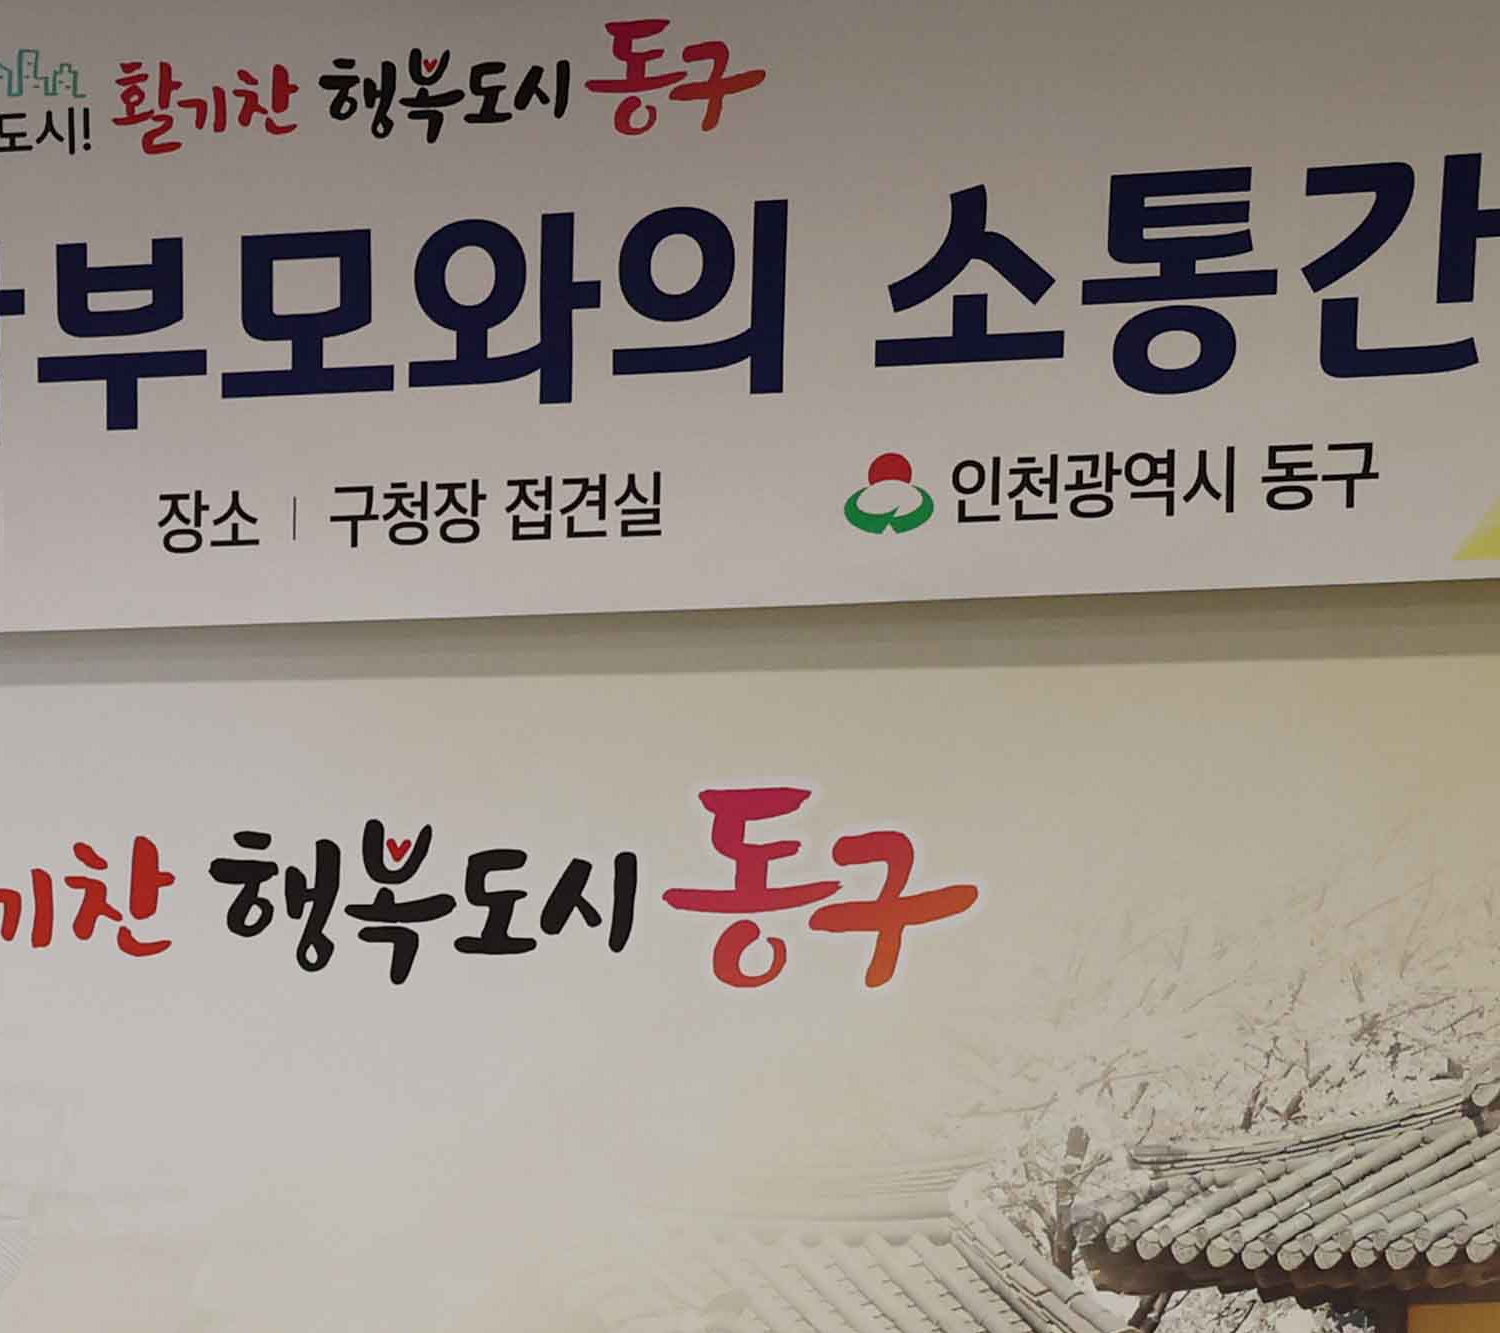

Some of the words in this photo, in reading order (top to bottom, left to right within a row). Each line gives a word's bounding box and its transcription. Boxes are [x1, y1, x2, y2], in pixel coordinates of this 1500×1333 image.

[111, 61, 300, 155] 활기찬
[318, 47, 571, 141] 행복도시
[584, 18, 766, 136] 동구
[874, 152, 1500, 395] 소통간
[157, 489, 260, 554] 장소
[329, 478, 487, 548] 구청장
[505, 471, 662, 541] 접견실
[951, 445, 1236, 523] 인천광역시
[1261, 442, 1380, 511] 동구
[208, 818, 638, 986] 행복도시
[661, 786, 979, 988] 동구
